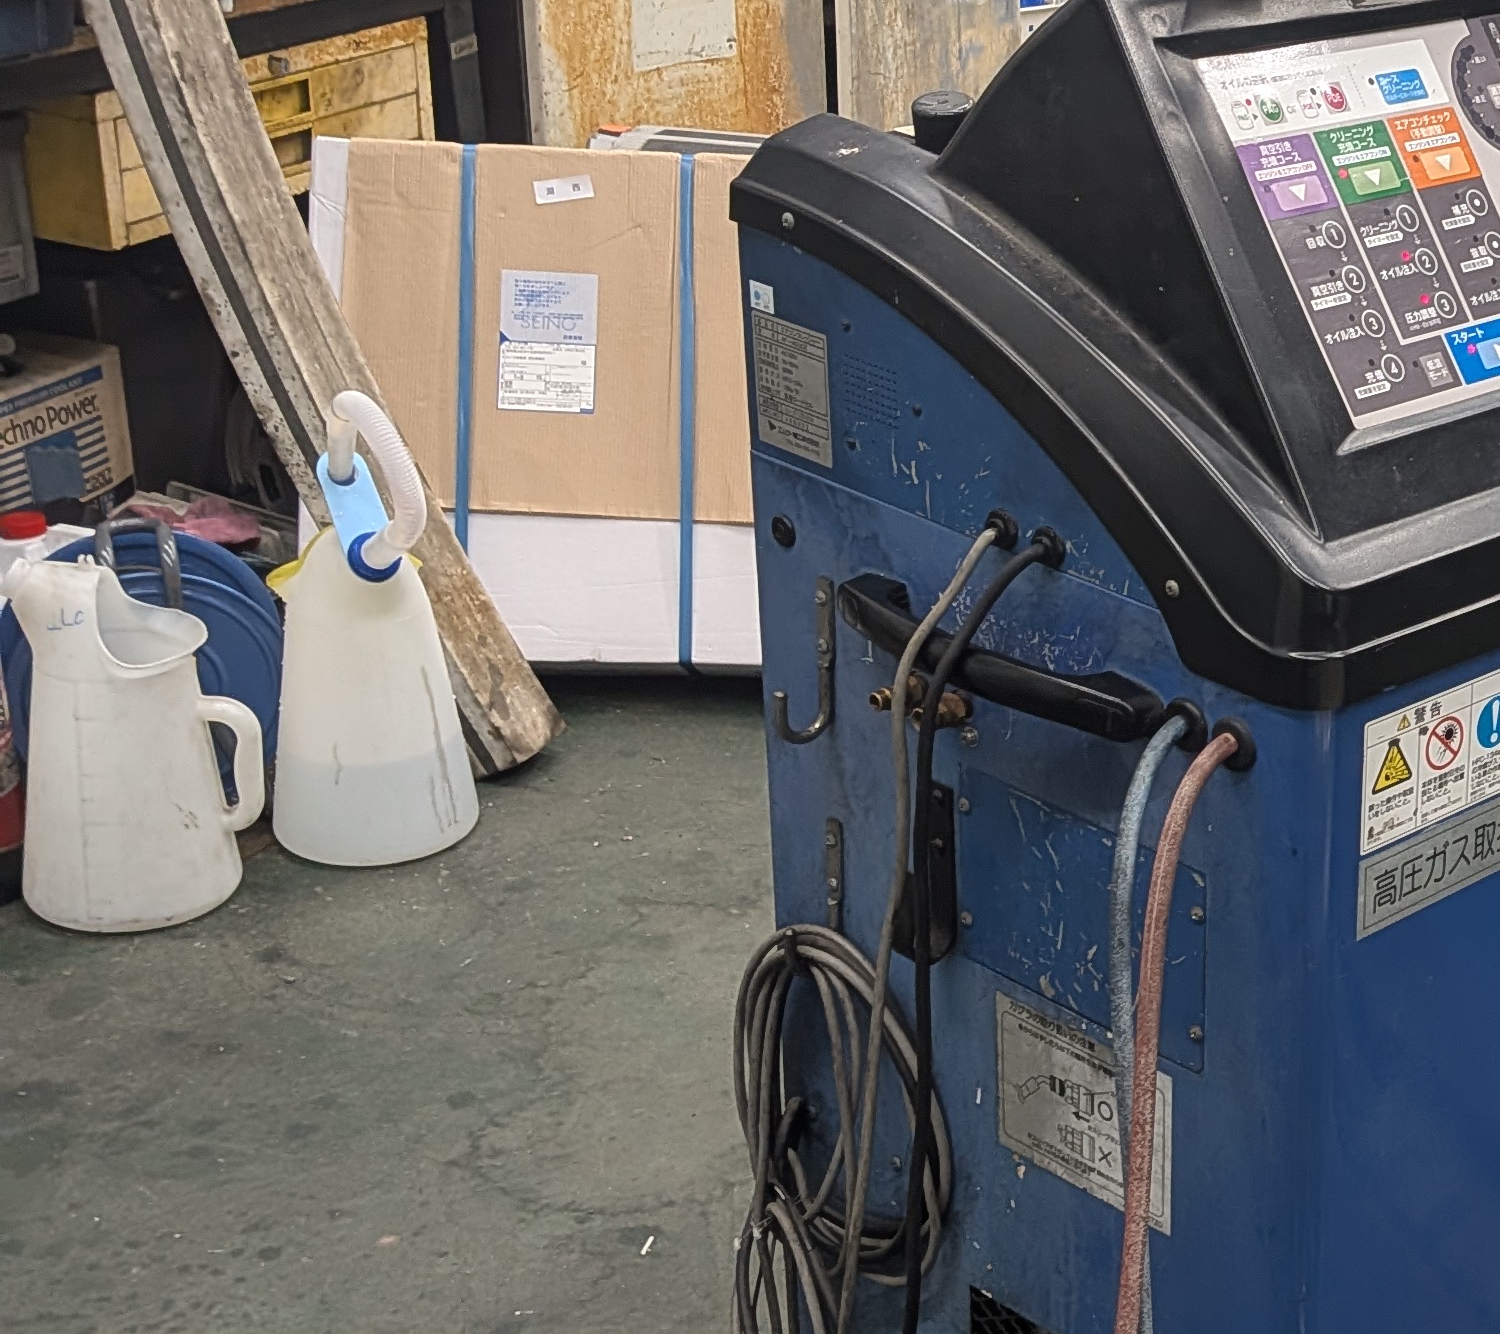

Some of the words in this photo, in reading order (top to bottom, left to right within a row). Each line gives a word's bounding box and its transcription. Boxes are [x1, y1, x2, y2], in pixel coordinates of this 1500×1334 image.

[1394, 111, 1451, 131] エアコンチェック
[1330, 126, 1374, 143] クリーニング
[1360, 220, 1398, 238] クリーニング
[1380, 263, 1418, 281] オイル注入
[1422, 255, 1431, 268] 2
[1349, 273, 1358, 286] 2
[1405, 307, 1438, 324] 圧力調整
[1441, 299, 1450, 311] 3
[1324, 327, 1364, 344] オイル注入
[1369, 317, 1378, 330] 3
[1451, 327, 1484, 345] スタート
[1389, 361, 1398, 375] 4
[1413, 700, 1443, 728] 警告
